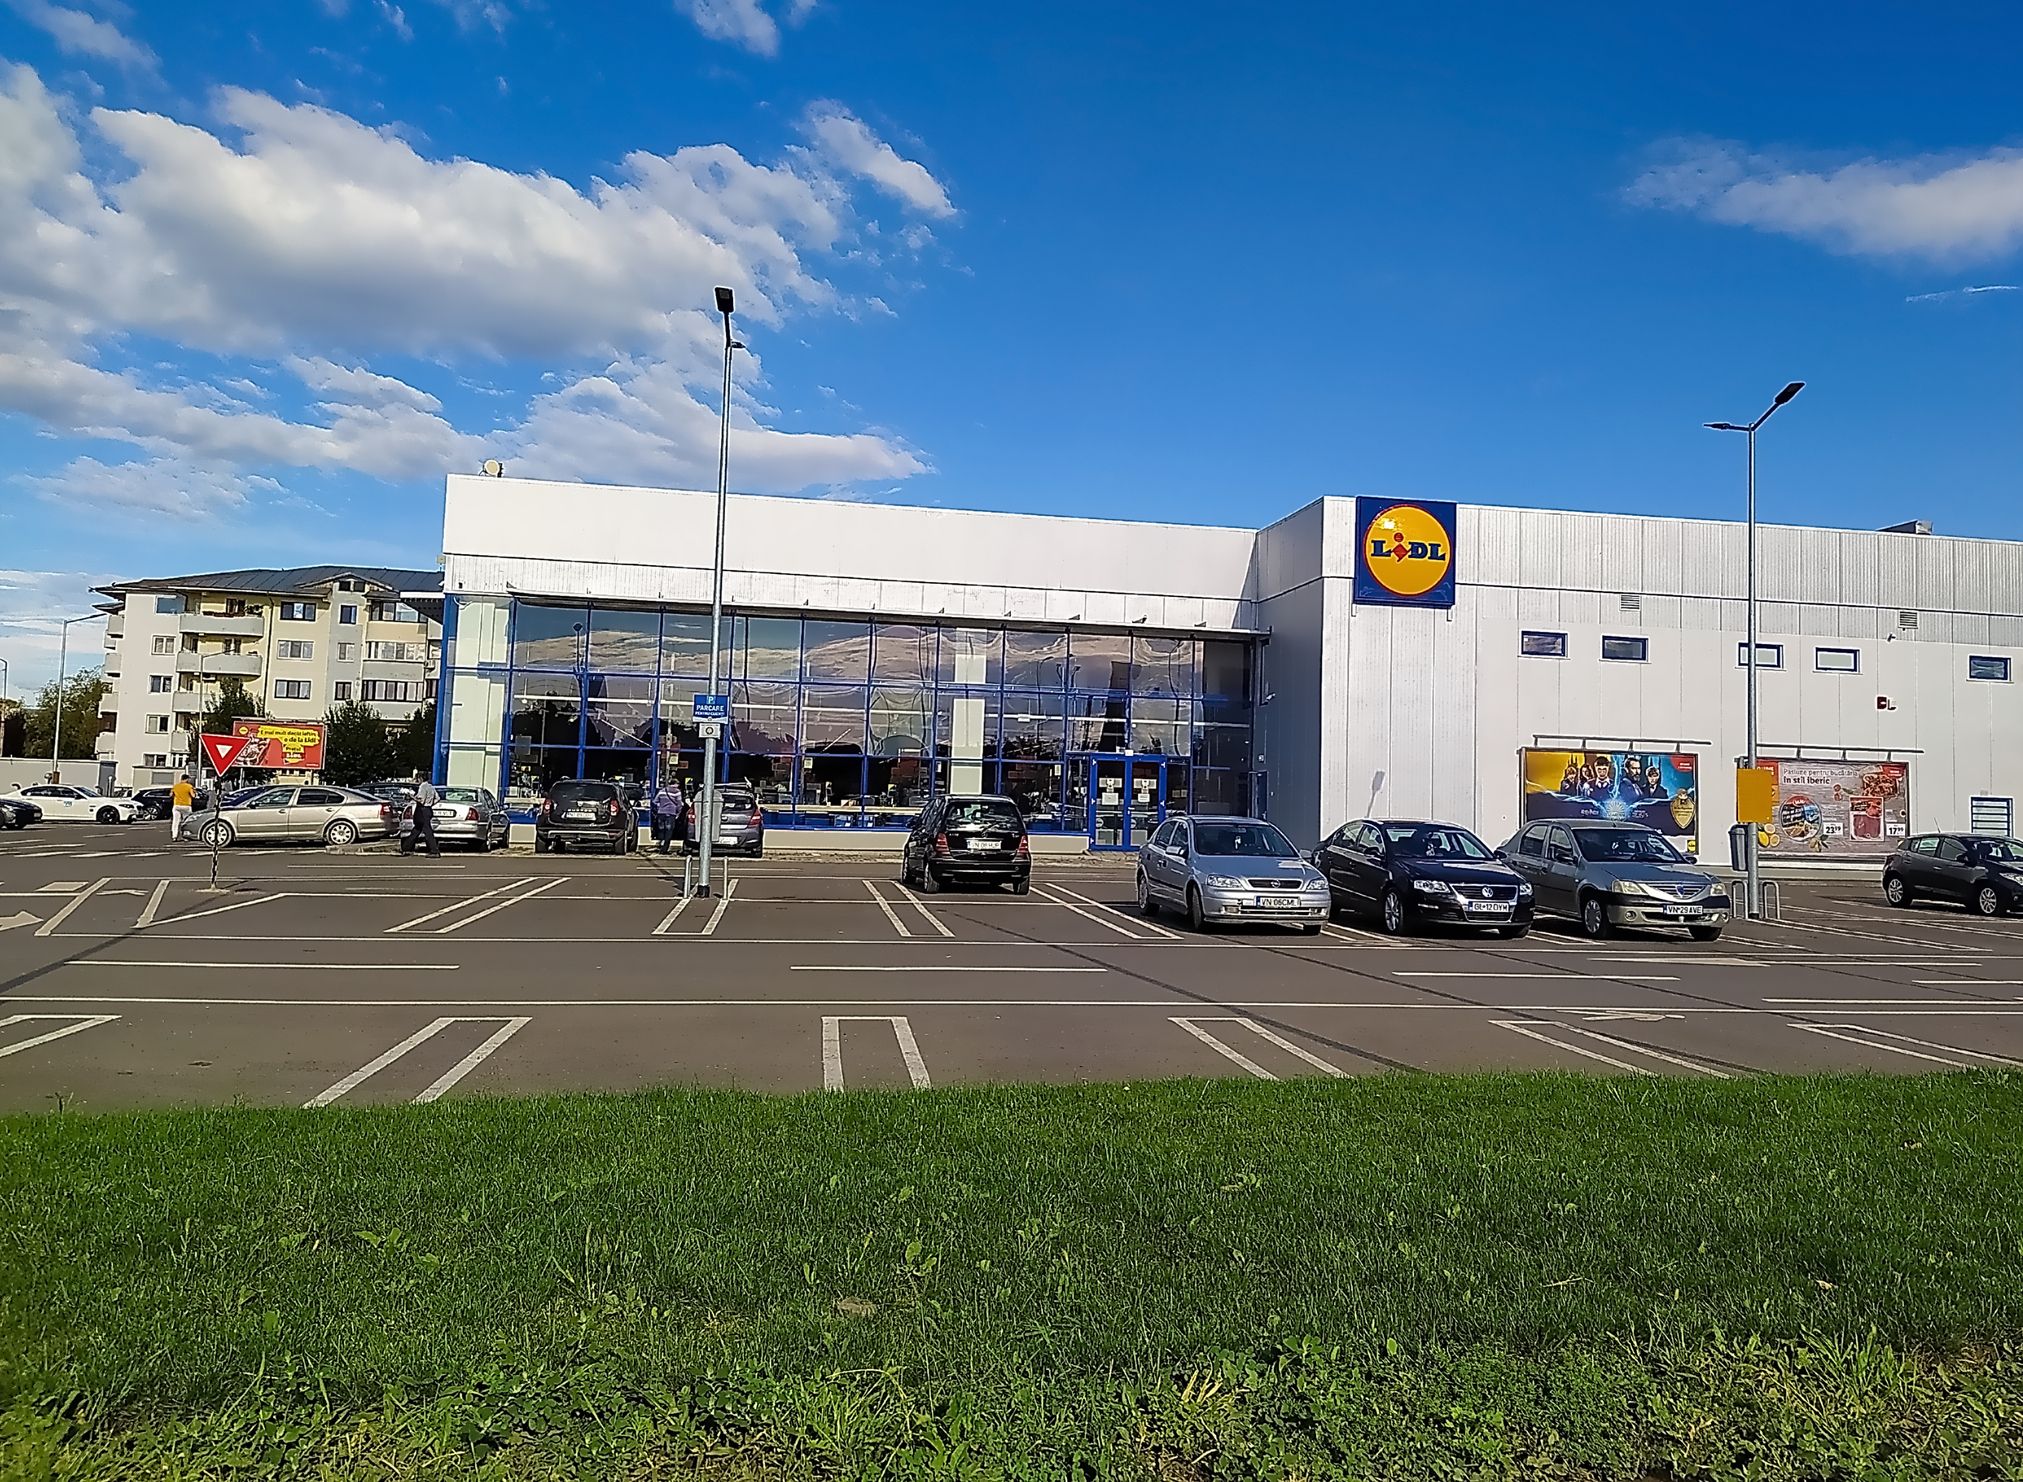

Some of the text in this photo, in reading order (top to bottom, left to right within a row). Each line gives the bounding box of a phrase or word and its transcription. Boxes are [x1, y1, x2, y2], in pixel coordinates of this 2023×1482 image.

[696, 704, 724, 712] PARCARE
[1793, 776, 1806, 784] stil
[1807, 776, 1831, 785] iberic
